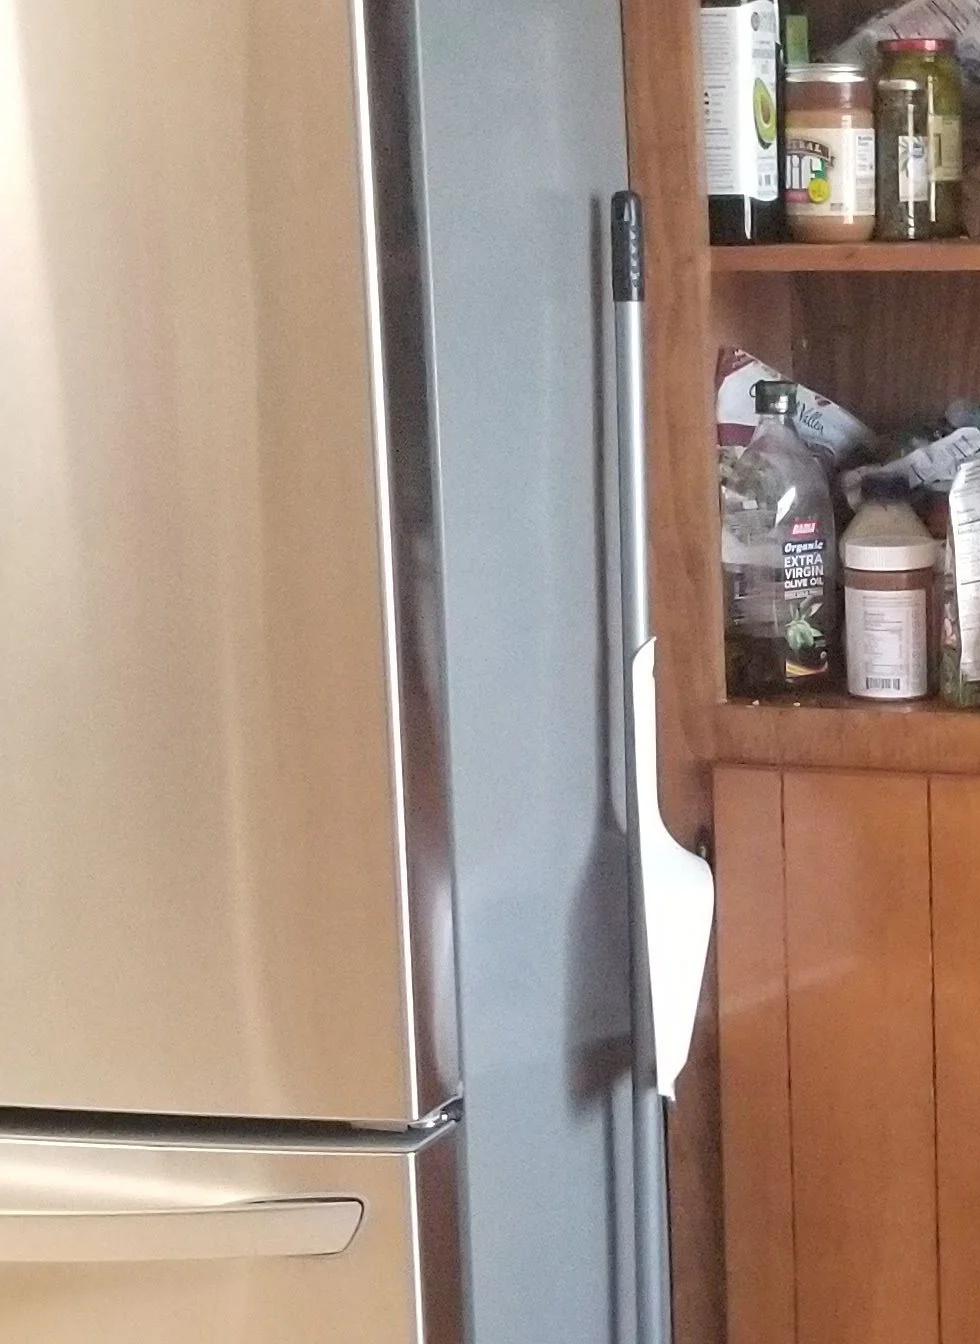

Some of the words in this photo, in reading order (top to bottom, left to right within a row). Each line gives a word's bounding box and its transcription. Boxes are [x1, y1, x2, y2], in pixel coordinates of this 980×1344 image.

[784, 540, 824, 554] Organic
[784, 554, 823, 568] EXTRA
[784, 565, 825, 580] VIRGIN
[784, 578, 808, 589] OLIVE
[810, 576, 824, 586] OIL
